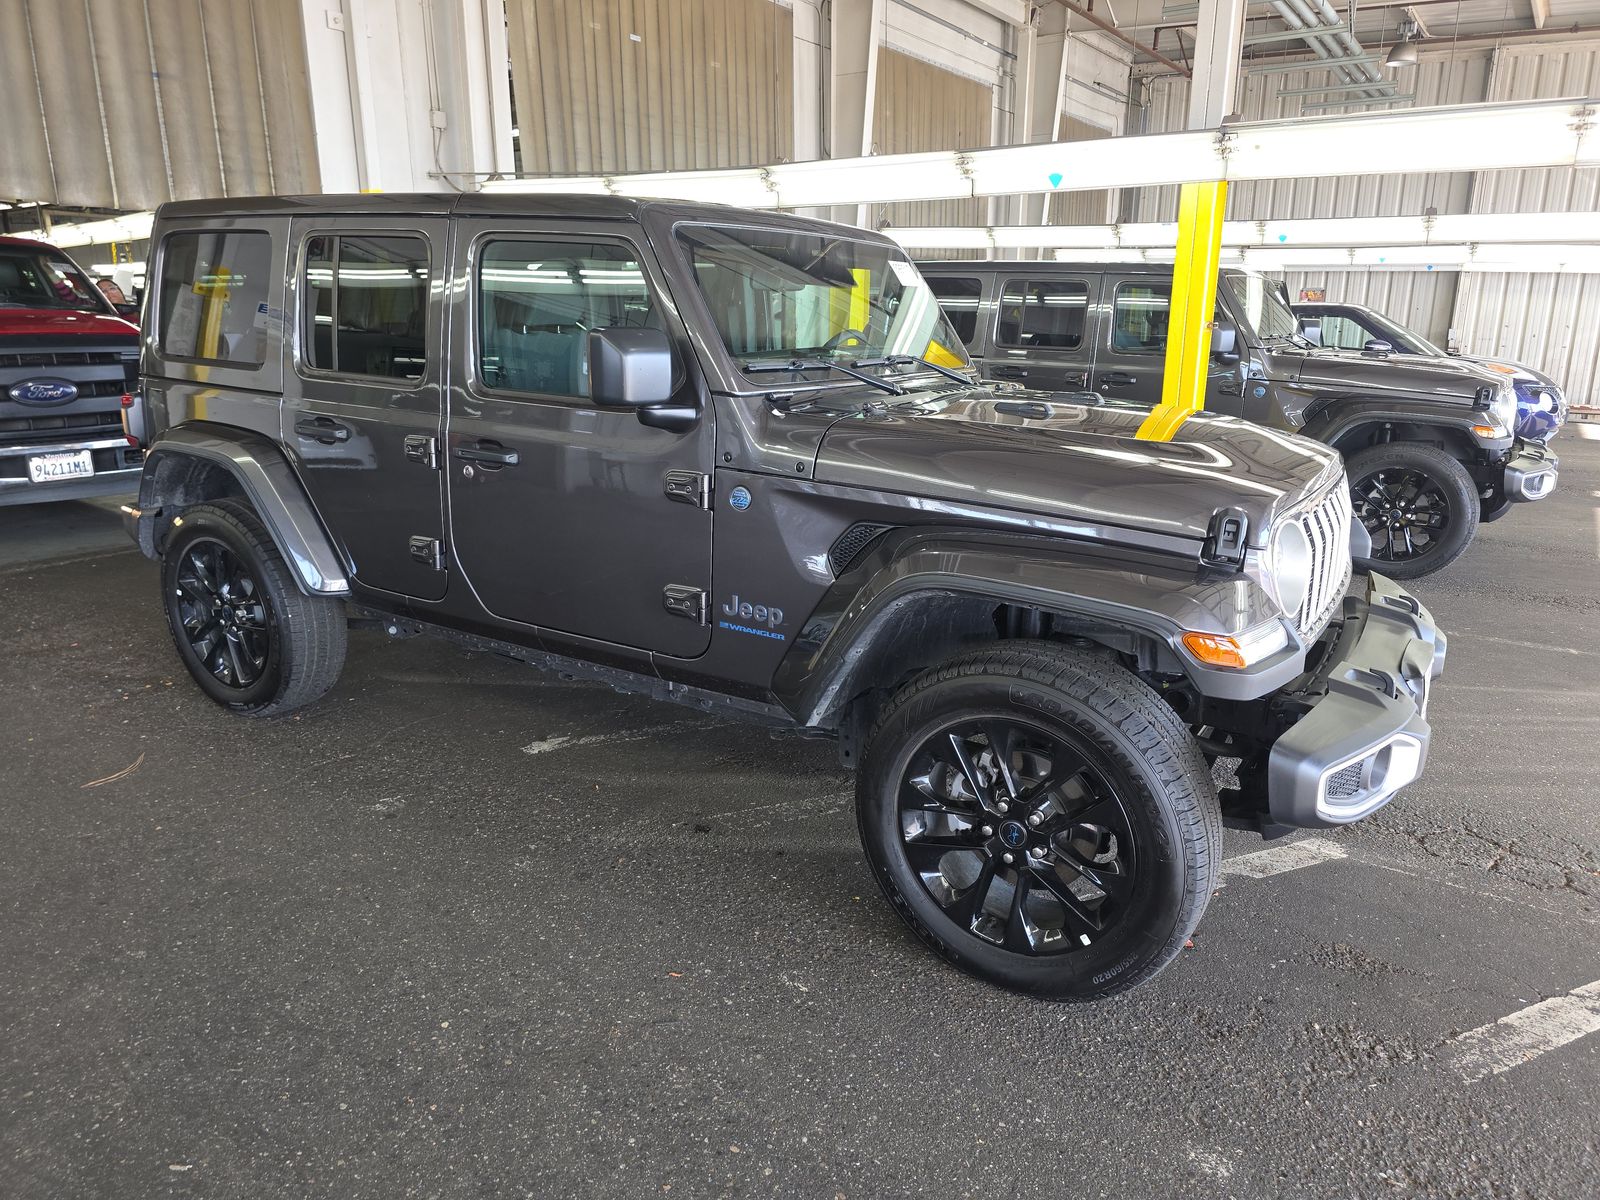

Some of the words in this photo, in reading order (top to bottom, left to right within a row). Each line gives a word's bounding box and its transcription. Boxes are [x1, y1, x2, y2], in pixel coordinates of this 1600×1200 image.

[28, 382, 63, 399] Ford
[35, 461, 90, 478] 94211M1
[722, 595, 783, 629] Jeep
[729, 623, 785, 641] WRANGLER
[1092, 952, 1138, 985] 255/60R20
